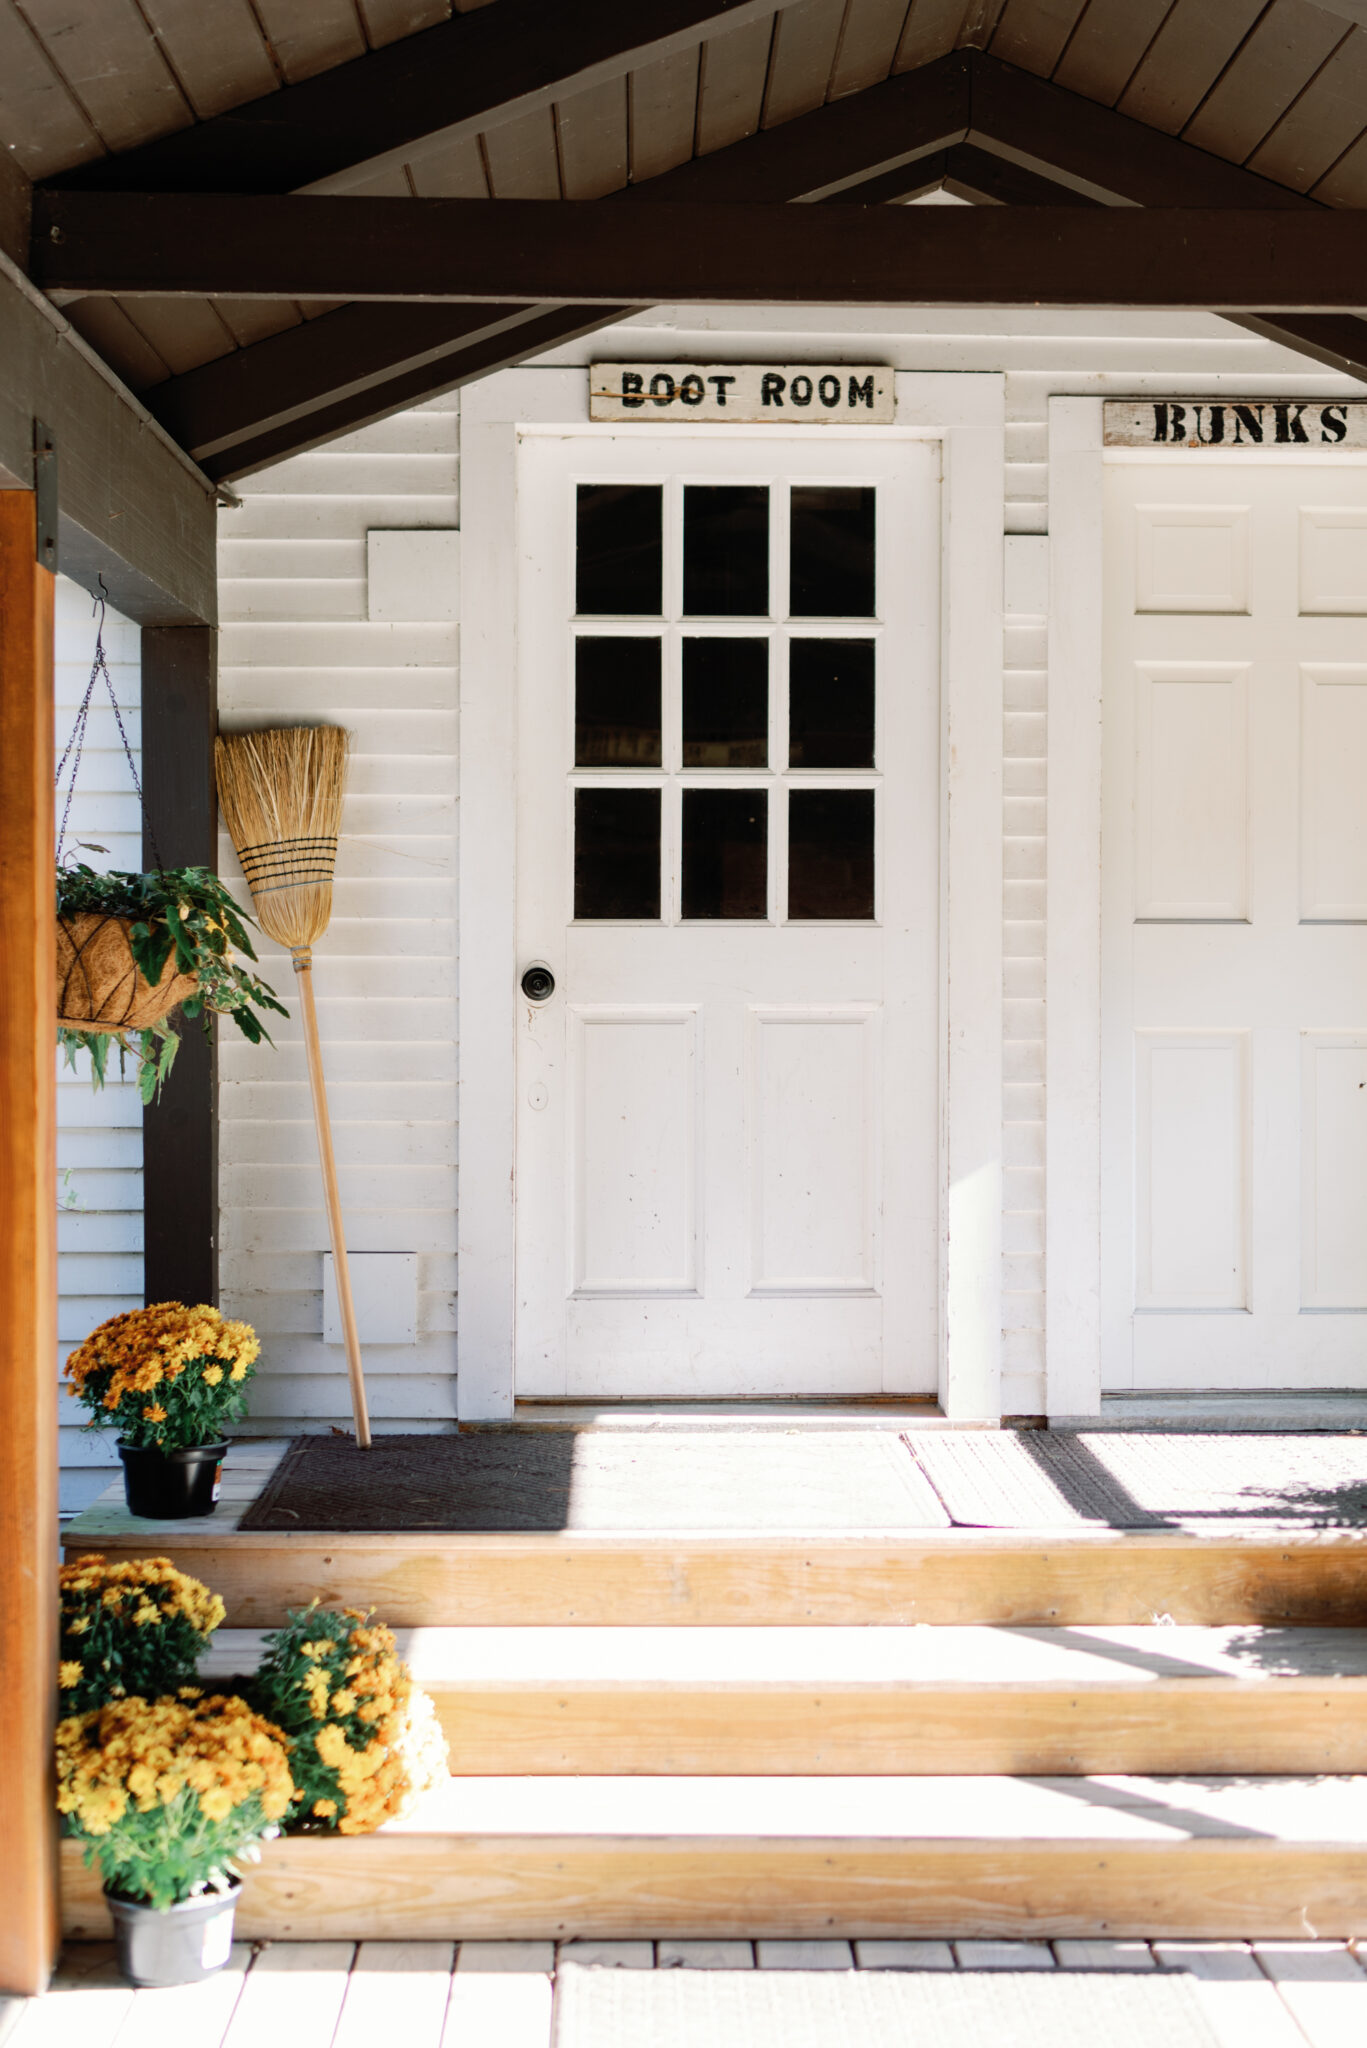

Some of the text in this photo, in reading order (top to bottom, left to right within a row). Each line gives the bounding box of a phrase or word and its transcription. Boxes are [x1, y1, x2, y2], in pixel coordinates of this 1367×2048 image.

[621, 372, 874, 408] BOOT ROOM
[1153, 403, 1348, 444] BUNKS
